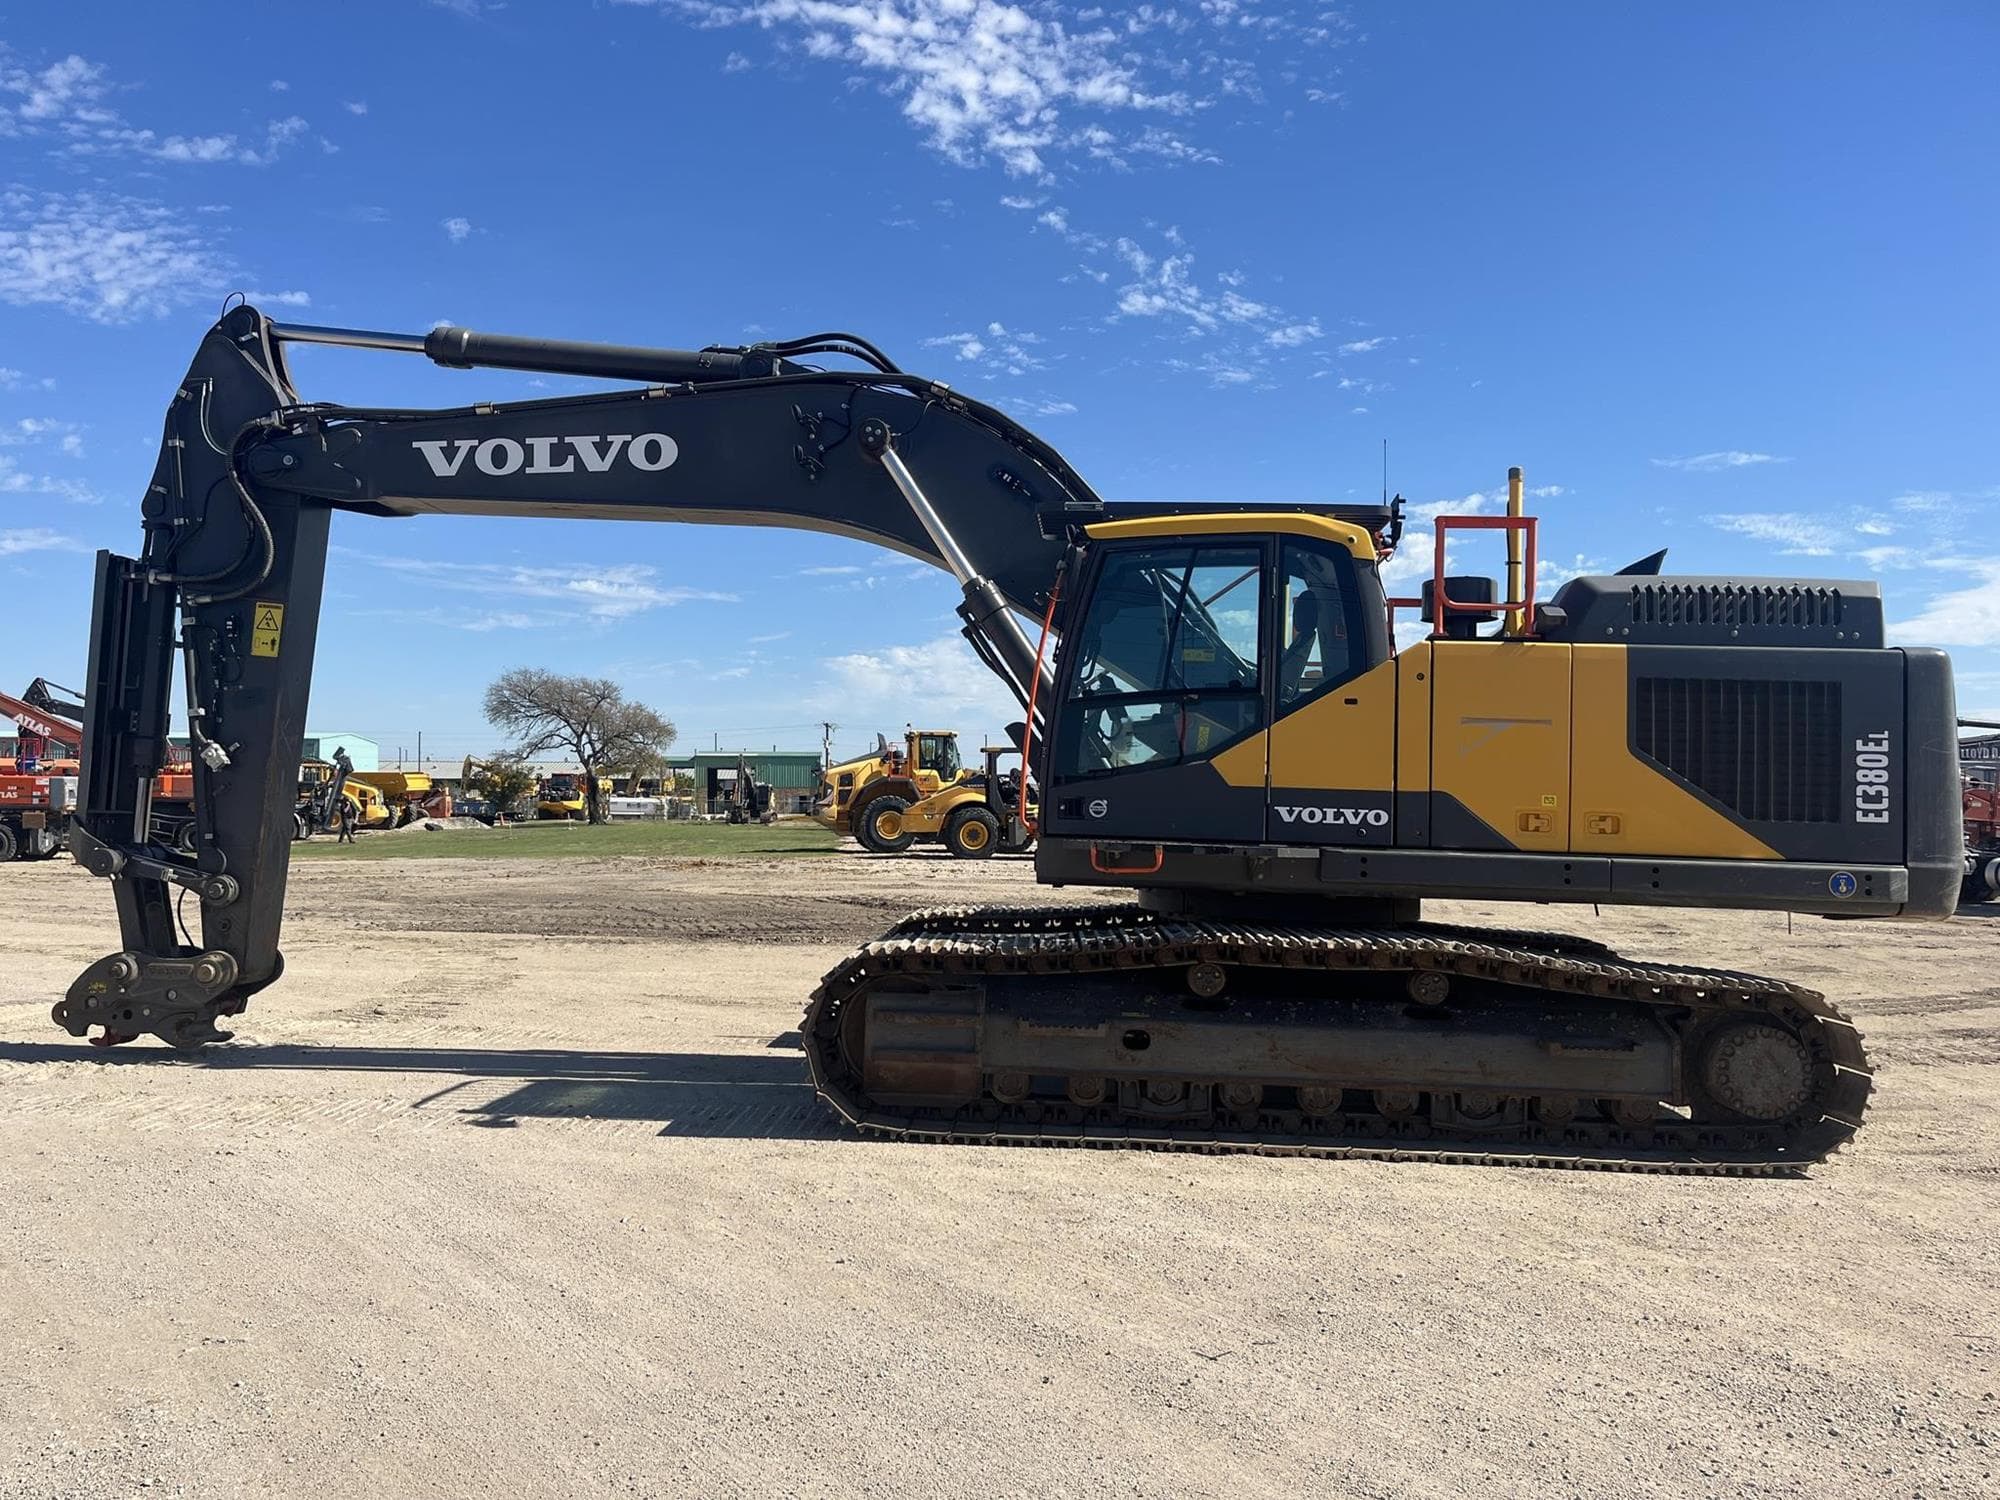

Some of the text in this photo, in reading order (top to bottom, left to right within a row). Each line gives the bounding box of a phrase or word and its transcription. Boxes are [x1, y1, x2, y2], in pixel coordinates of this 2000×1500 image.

[411, 433, 679, 477] VOLVO
[13, 713, 52, 737] ATLAS
[1960, 747, 1989, 759] LLOYD
[1855, 730, 1889, 824] EC380EL
[1274, 805, 1389, 826] VOLVO
